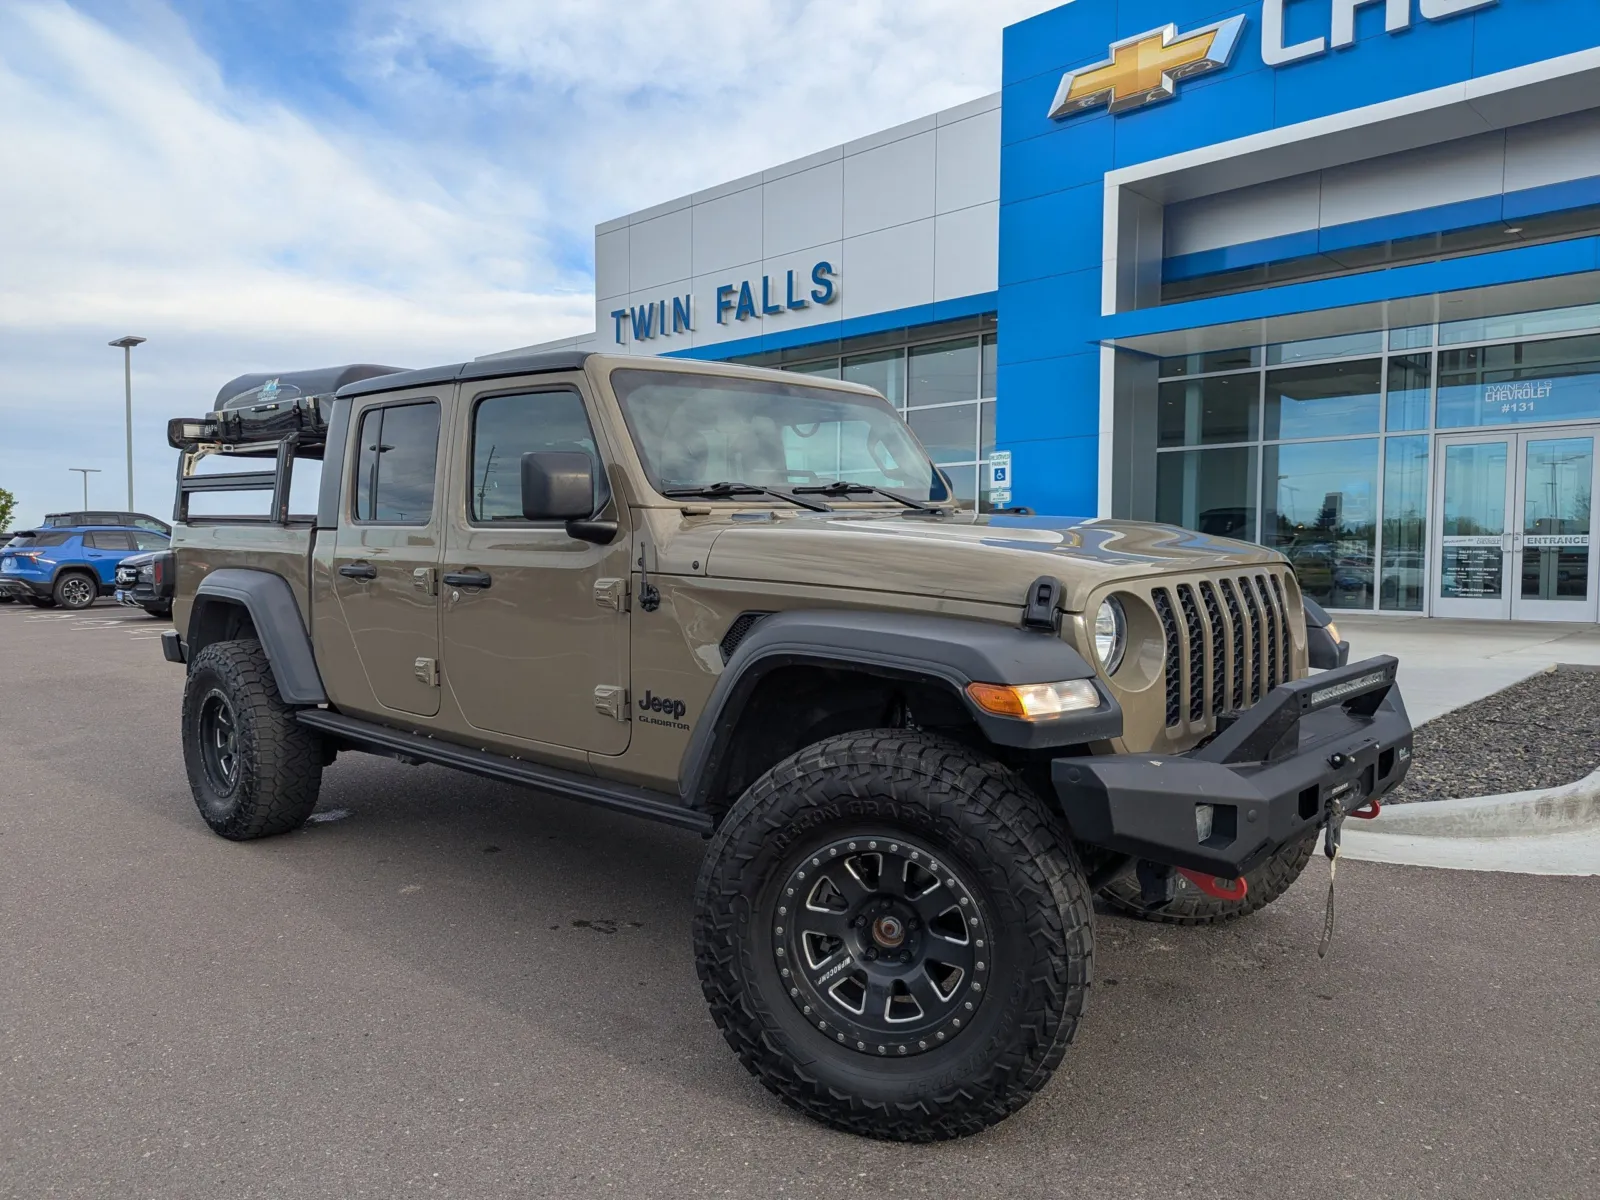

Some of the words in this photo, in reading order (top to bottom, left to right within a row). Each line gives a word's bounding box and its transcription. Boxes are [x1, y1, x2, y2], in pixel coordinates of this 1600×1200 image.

[611, 294, 695, 344] TWIN
[717, 261, 836, 325] FALLS
[1485, 387, 1552, 402] CHEVROLET
[1502, 401, 1534, 413] #131
[1527, 536, 1588, 545] ENTRANCE
[639, 690, 686, 720] Jeep
[639, 715, 690, 731] GLADIATOR
